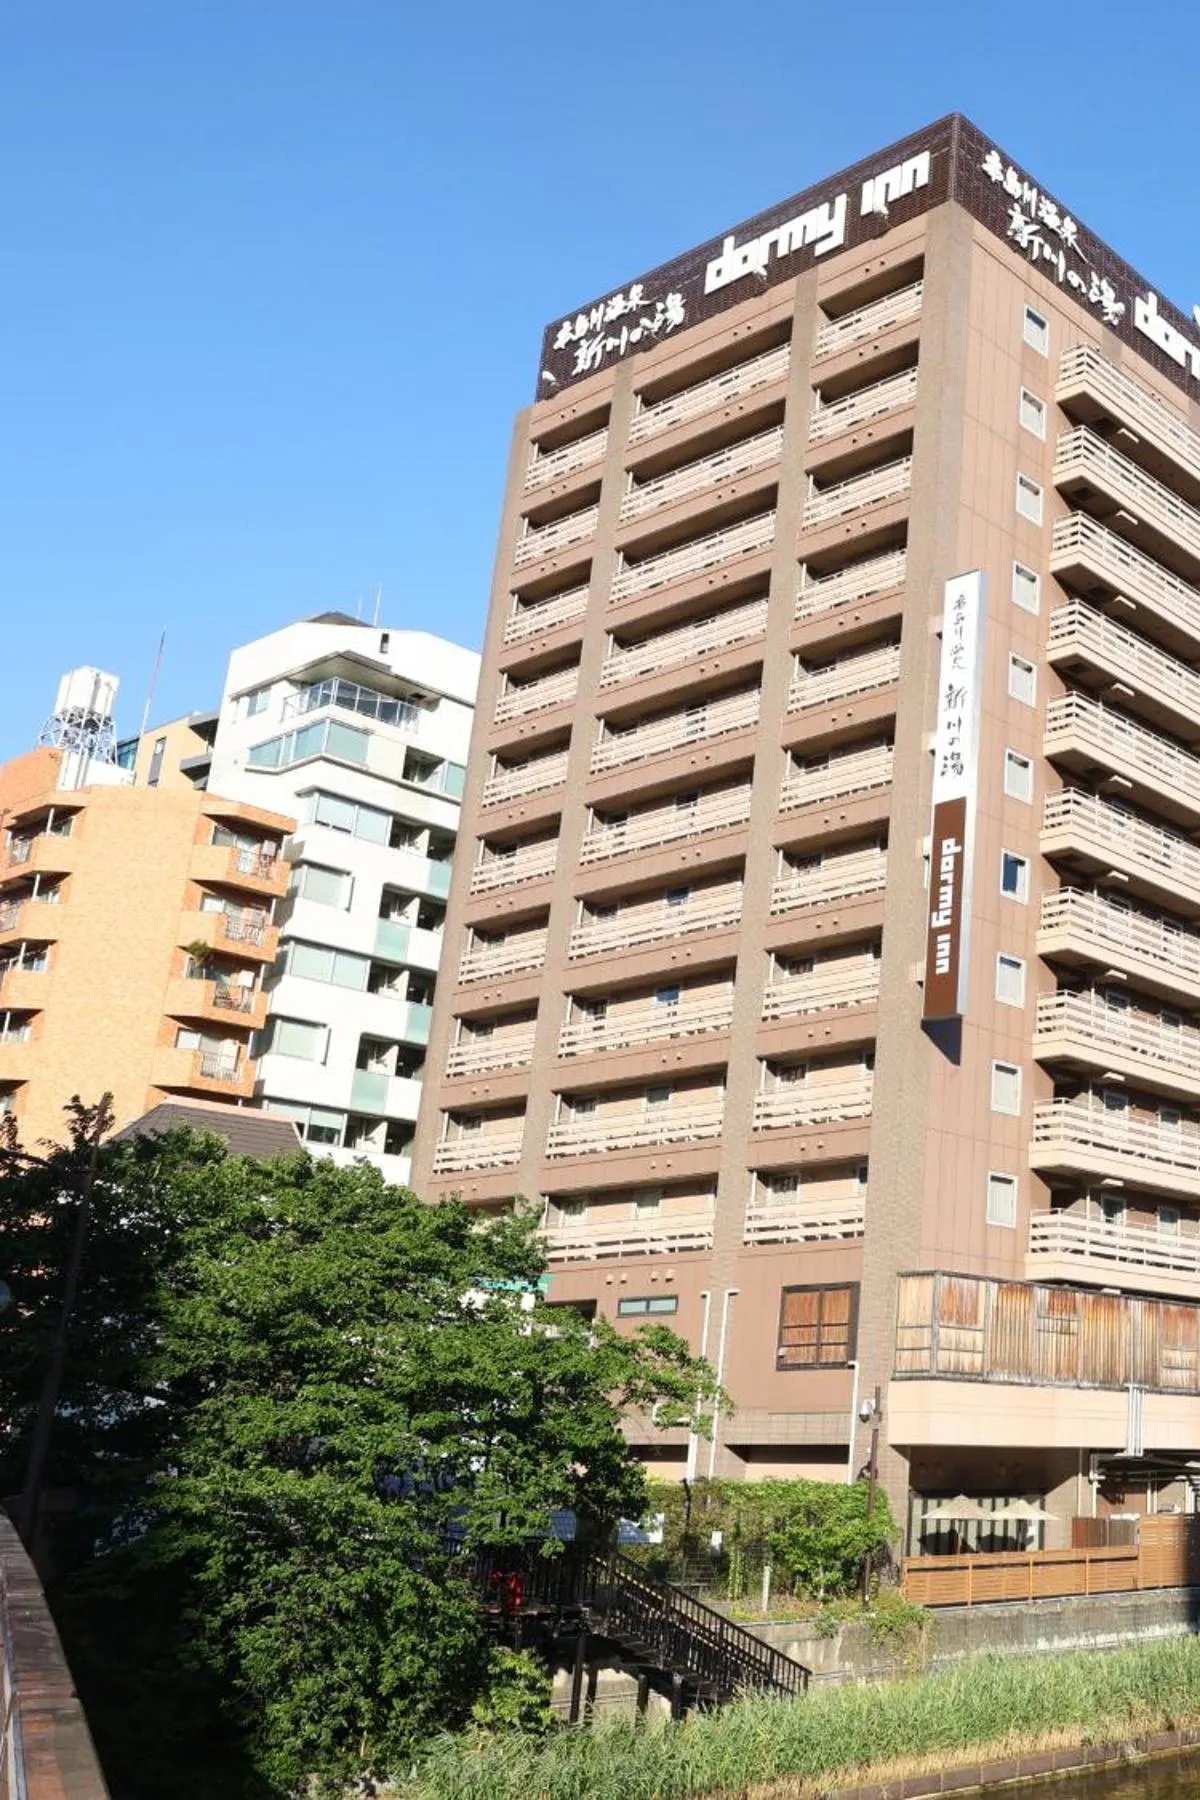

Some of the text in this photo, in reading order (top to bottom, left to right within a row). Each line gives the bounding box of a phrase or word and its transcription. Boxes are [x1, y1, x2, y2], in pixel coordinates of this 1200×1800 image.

[704, 151, 930, 295] dormy inn
[931, 838, 962, 975] dormy inn
